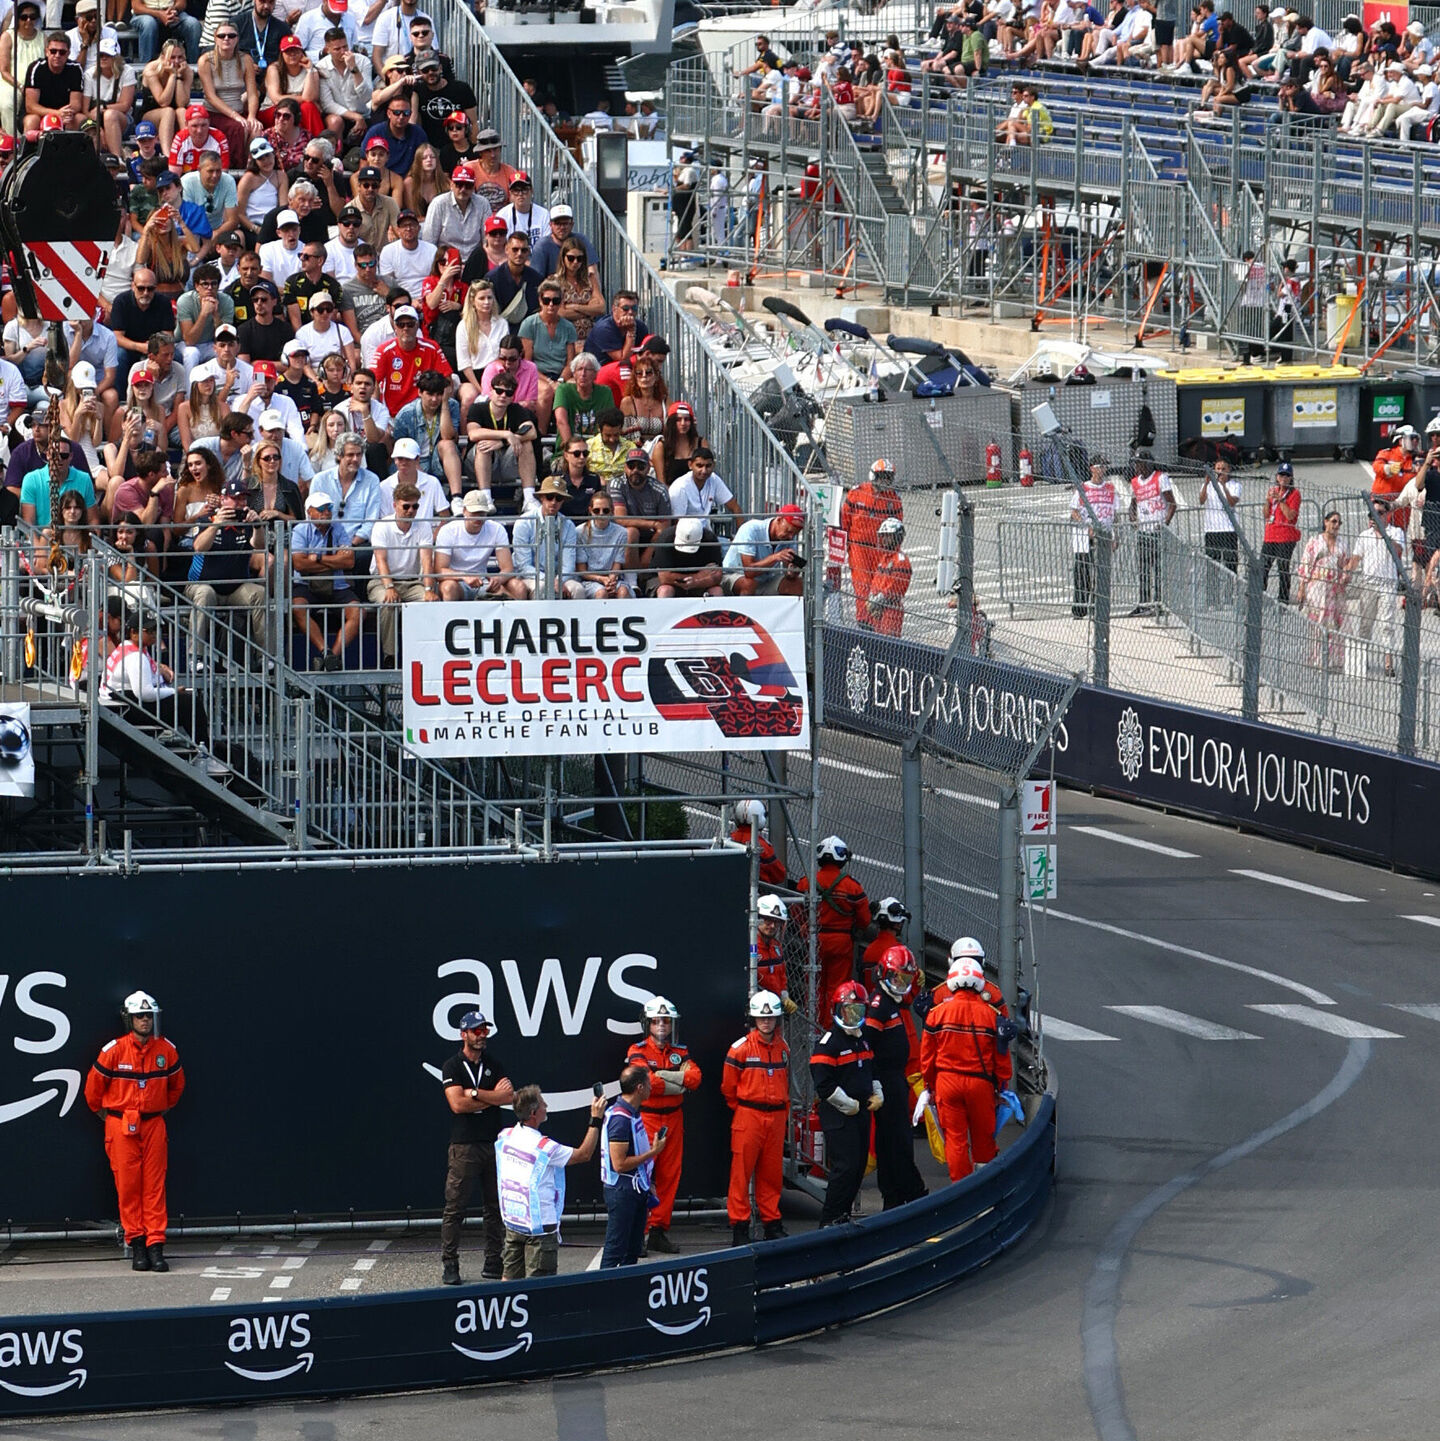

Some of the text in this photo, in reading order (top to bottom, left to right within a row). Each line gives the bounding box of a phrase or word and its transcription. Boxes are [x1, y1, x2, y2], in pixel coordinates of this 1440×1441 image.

[444, 616, 648, 657] CHARLES
[411, 657, 644, 706] LECLERC
[464, 707, 630, 724] THE OFFICIAL
[873, 661, 1070, 754] EXPLORA JOURNEYS
[434, 722, 660, 741] MARCHE FAN CLUB
[1148, 726, 1371, 826] EXPLORA JOURNEYS
[433, 954, 672, 1041] aws
[648, 1268, 709, 1309] aws
[229, 1314, 311, 1353] aws
[455, 1295, 529, 1333] aws
